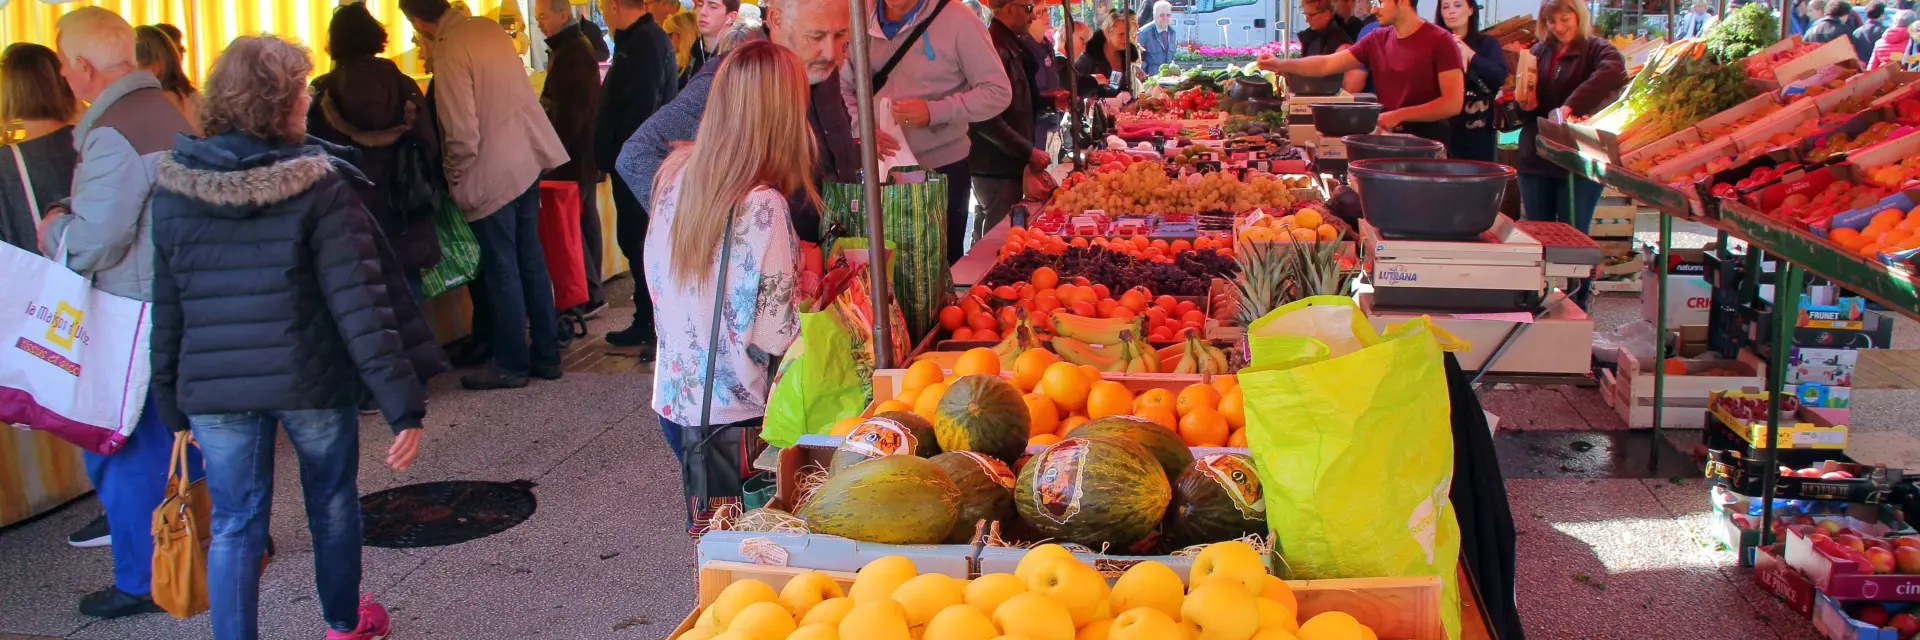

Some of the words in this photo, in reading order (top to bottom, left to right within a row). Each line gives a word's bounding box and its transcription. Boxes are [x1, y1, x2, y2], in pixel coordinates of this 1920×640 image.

[1379, 271, 1417, 282] LUTRANA
[25, 301, 37, 316] la
[36, 305, 69, 331] Maison
[1809, 311, 1840, 320] FRUNET
[21, 339, 48, 359] tissus
[1762, 569, 1771, 586] LE
[1772, 575, 1797, 603] PRINCE
